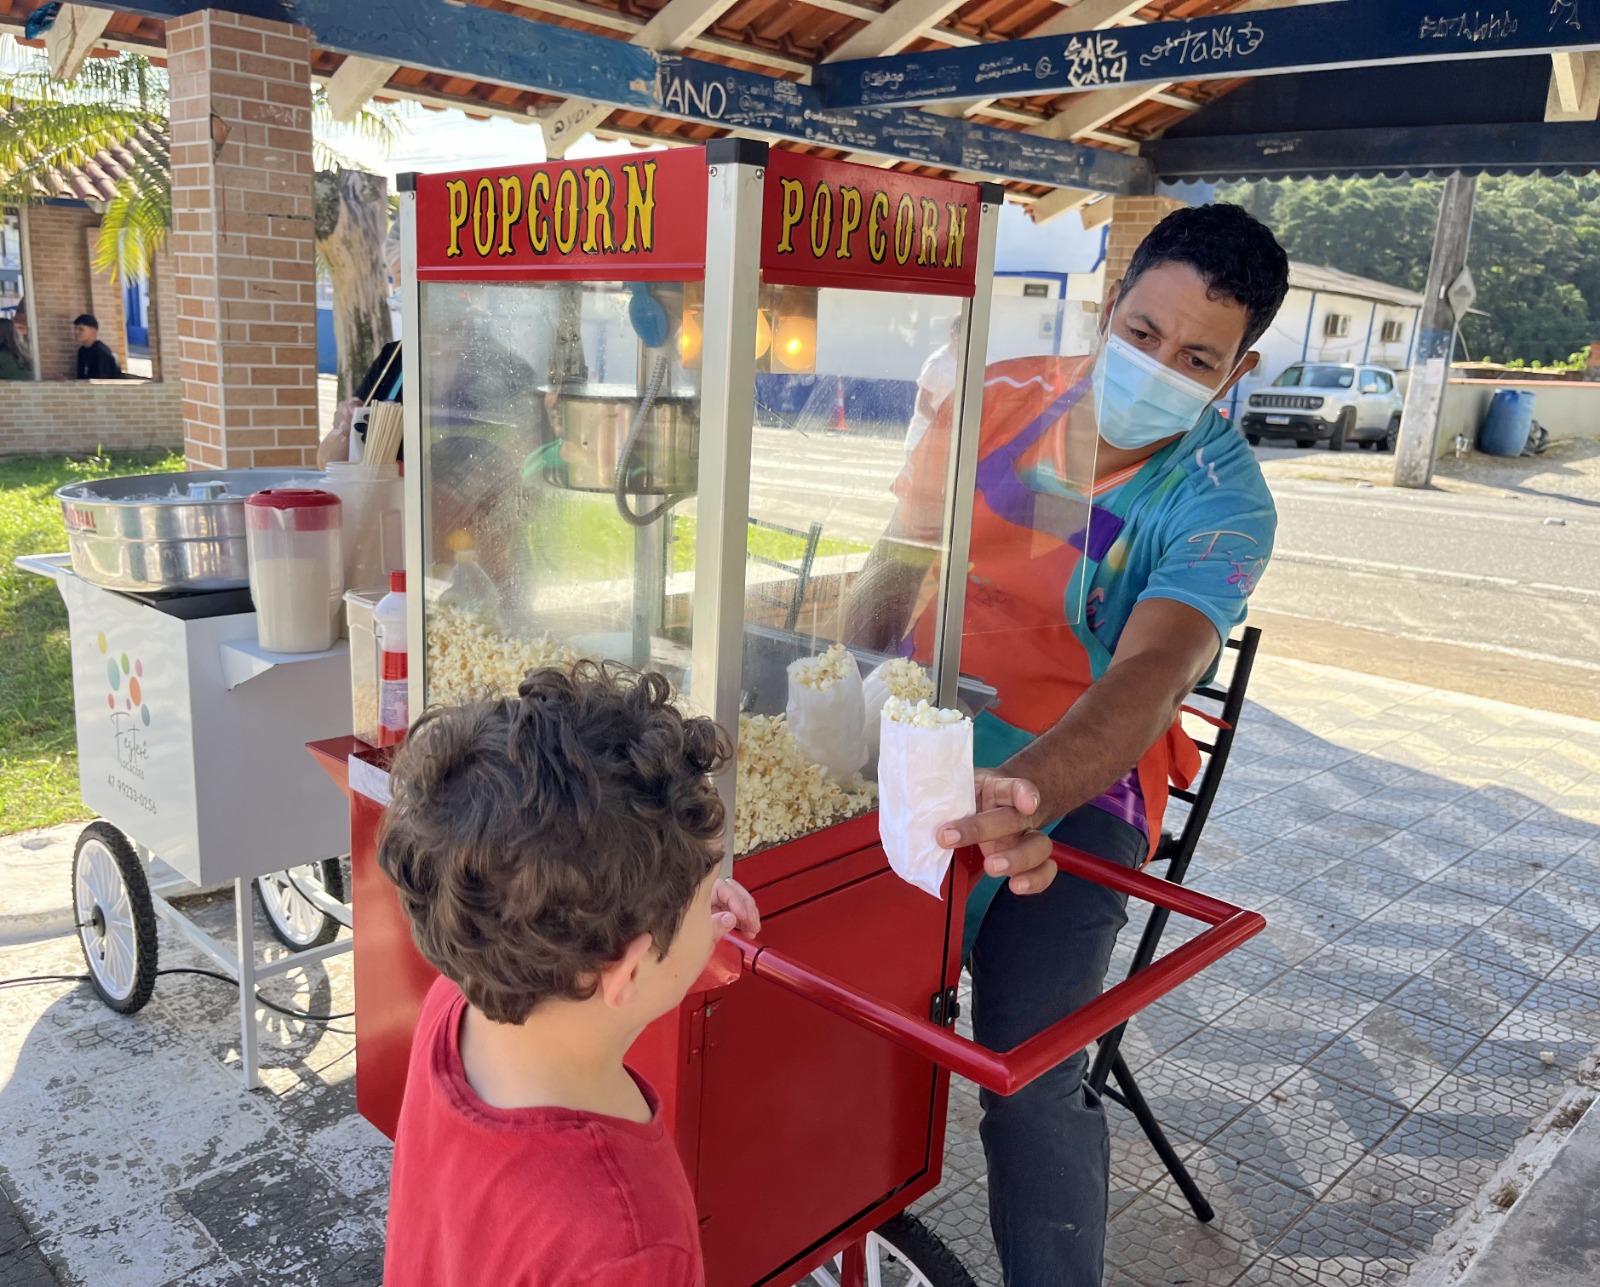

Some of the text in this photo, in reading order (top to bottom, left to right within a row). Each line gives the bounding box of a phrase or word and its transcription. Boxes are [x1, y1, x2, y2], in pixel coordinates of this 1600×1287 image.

[446, 159, 657, 258] POPCORN
[777, 177, 968, 268] POPCORN
[117, 780, 157, 814] 99233-0256
